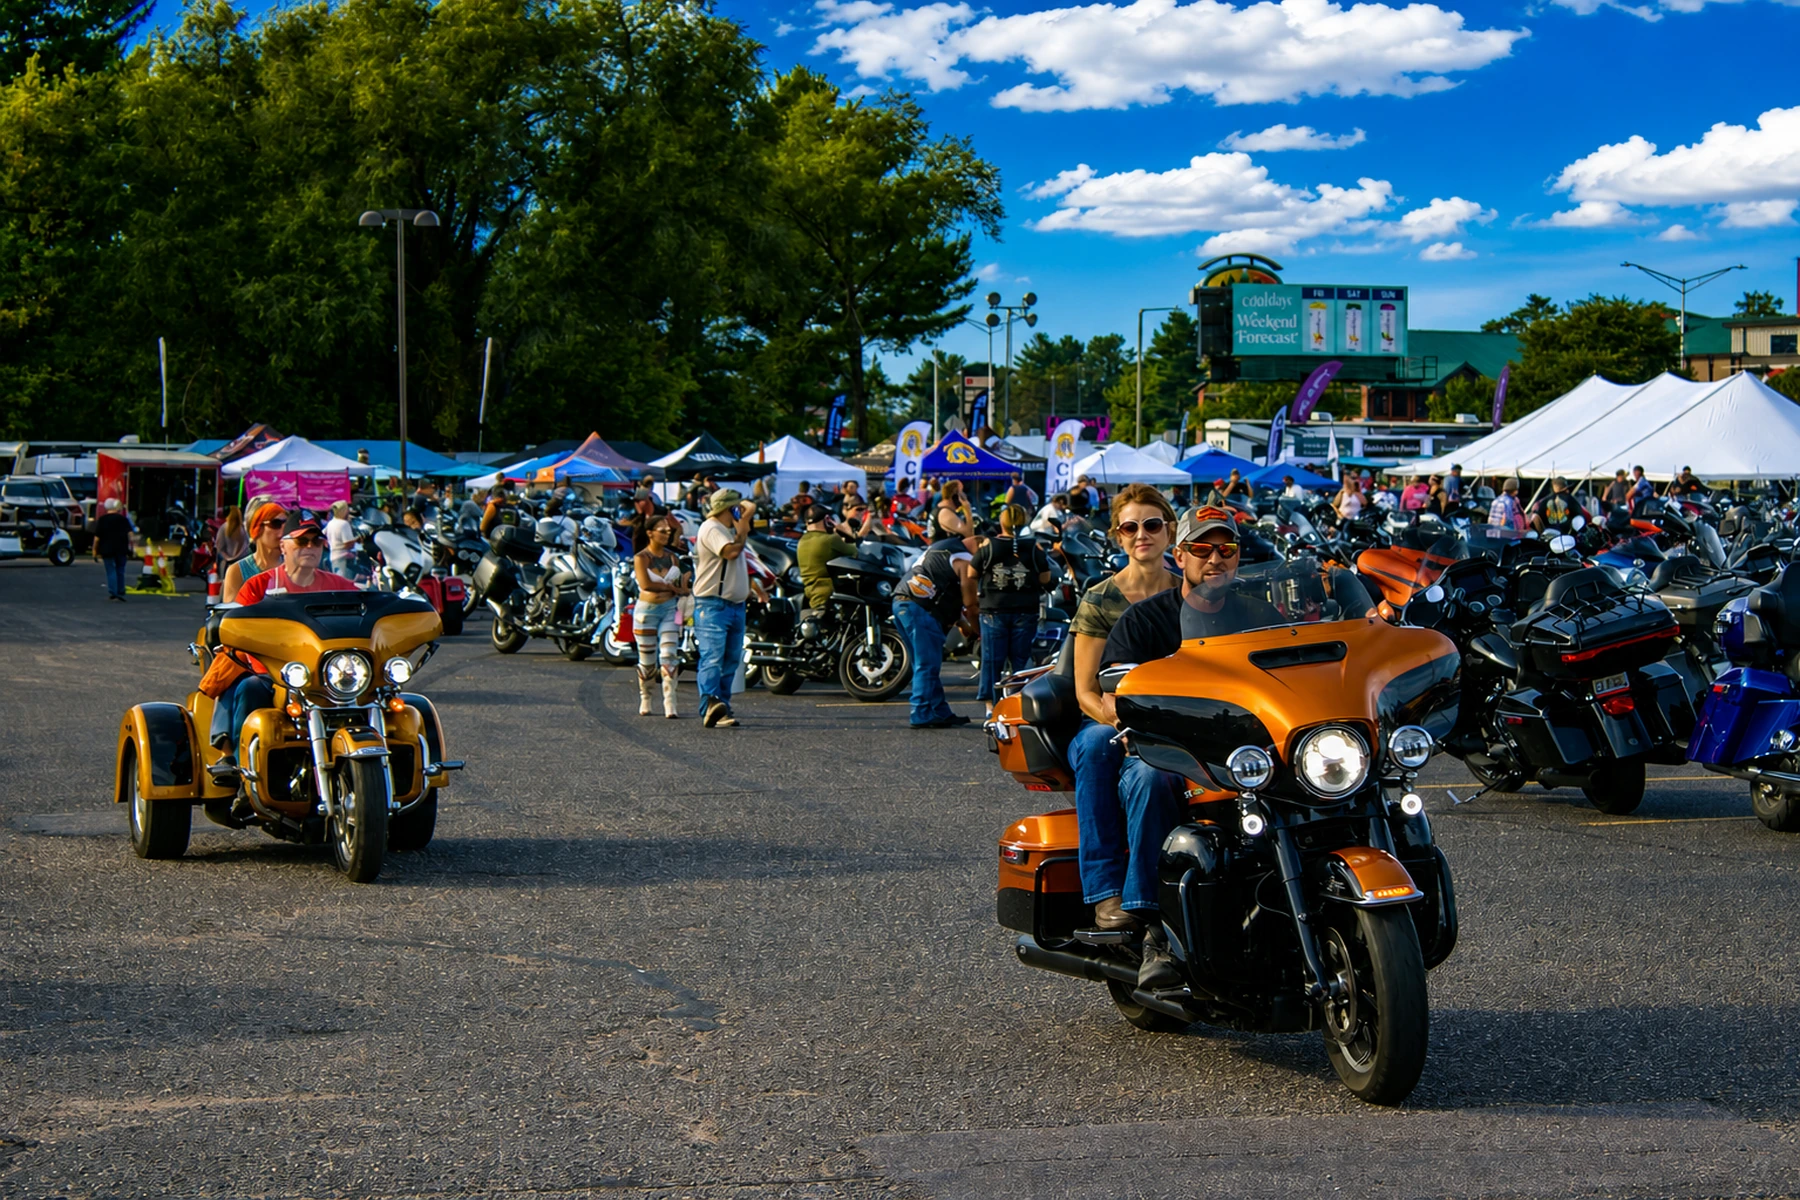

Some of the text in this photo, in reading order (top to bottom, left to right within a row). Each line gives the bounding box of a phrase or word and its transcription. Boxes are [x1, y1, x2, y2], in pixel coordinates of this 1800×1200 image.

[1347, 290, 1361, 298] SAT
[1237, 311, 1297, 331] Weekend
[1235, 330, 1299, 343] Forecast
